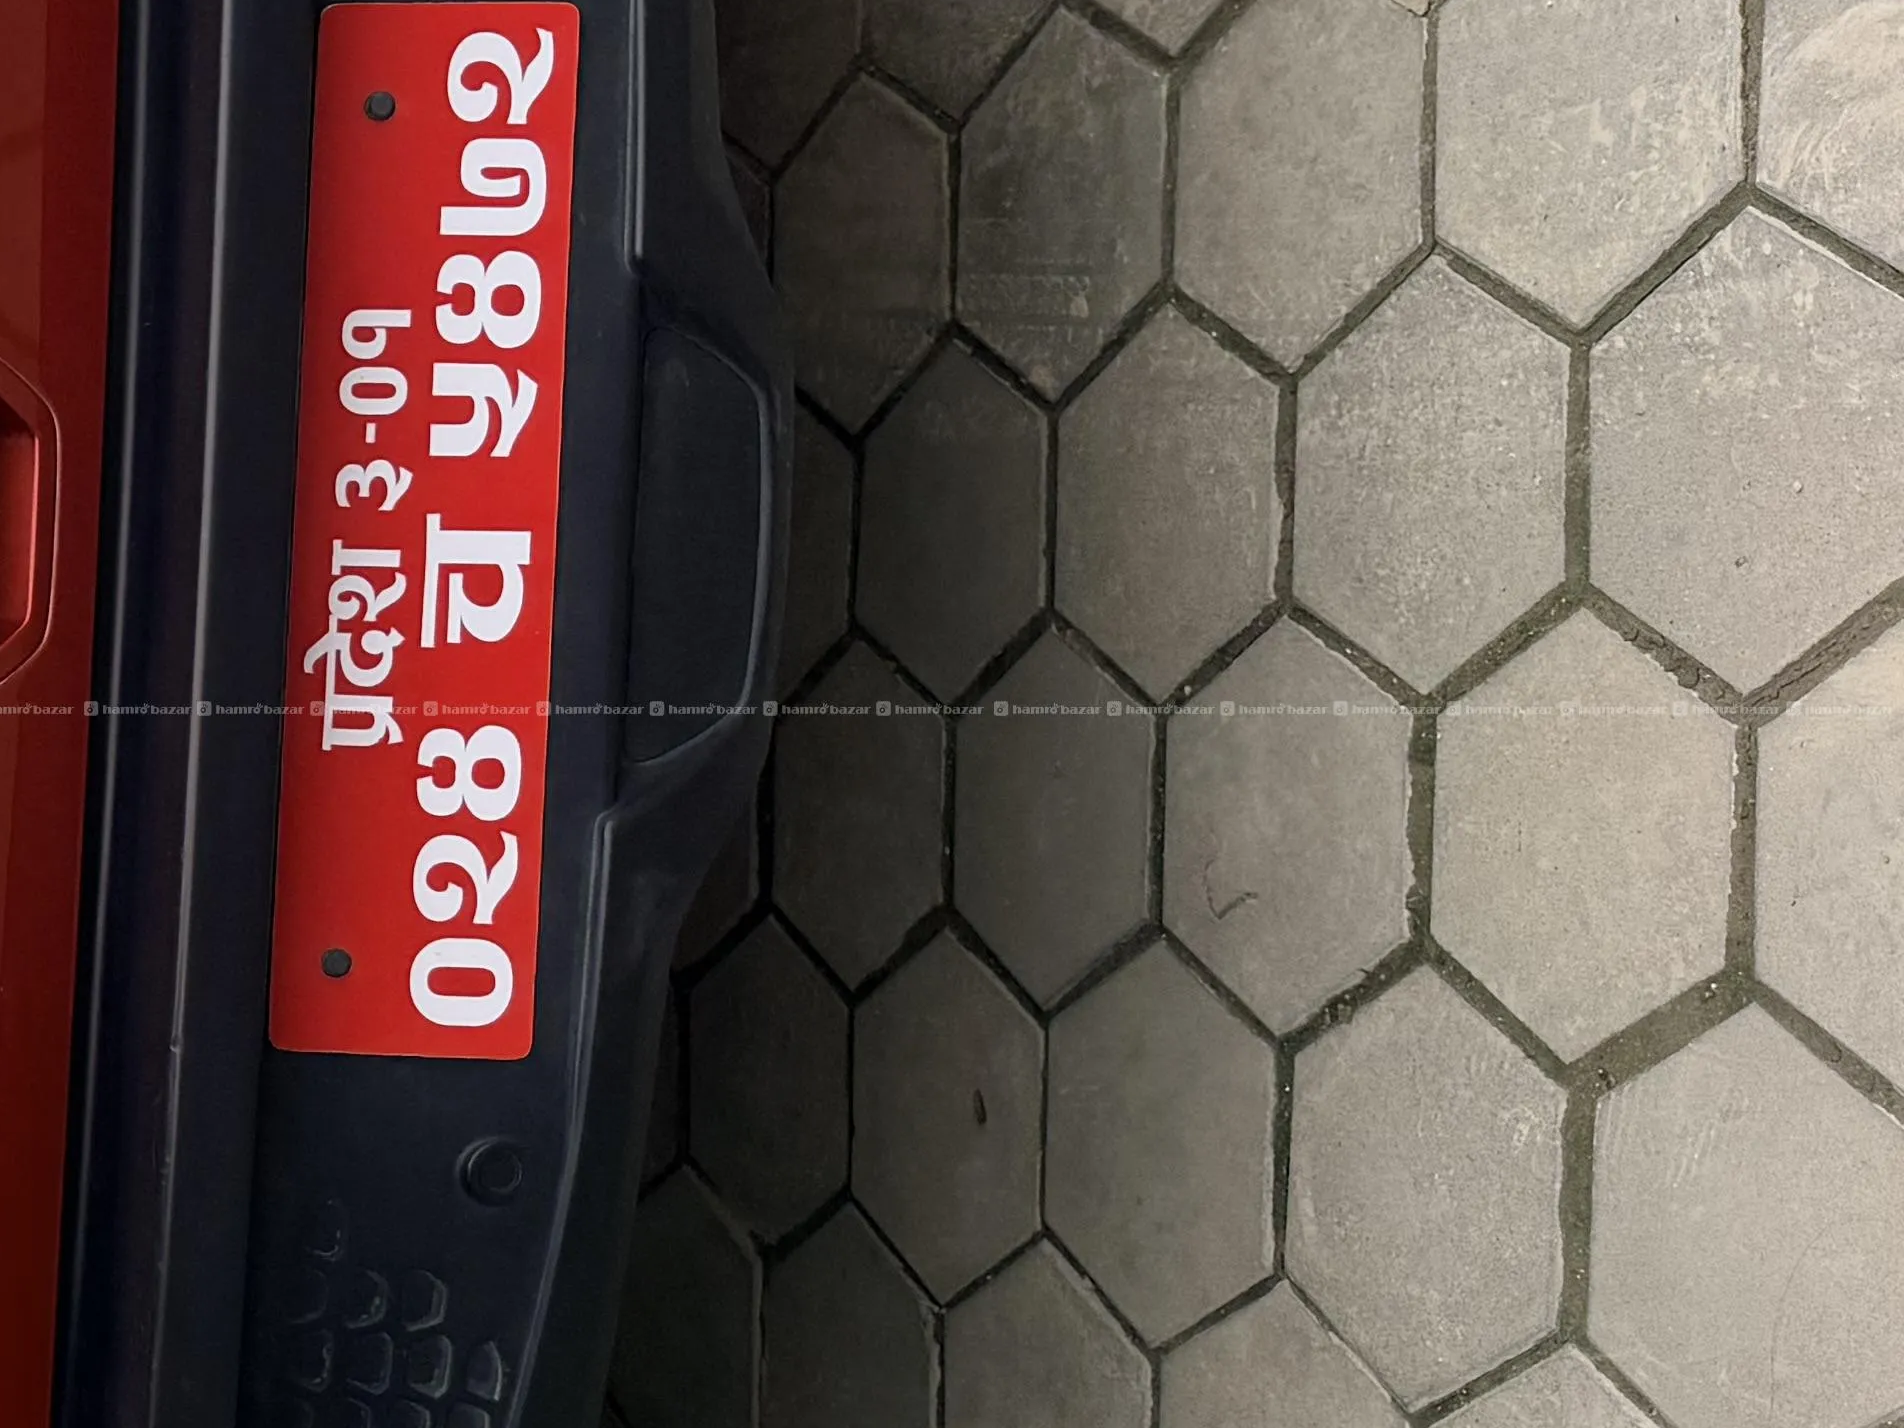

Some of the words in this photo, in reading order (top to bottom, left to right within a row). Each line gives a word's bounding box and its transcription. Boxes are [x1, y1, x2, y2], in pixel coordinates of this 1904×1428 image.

[426, 26, 555, 459] ५४७२
[334, 307, 412, 510] ३-०१
[302, 539, 407, 751] प्रदेश
[419, 512, 533, 649] च
[409, 723, 524, 1027] ०२४
